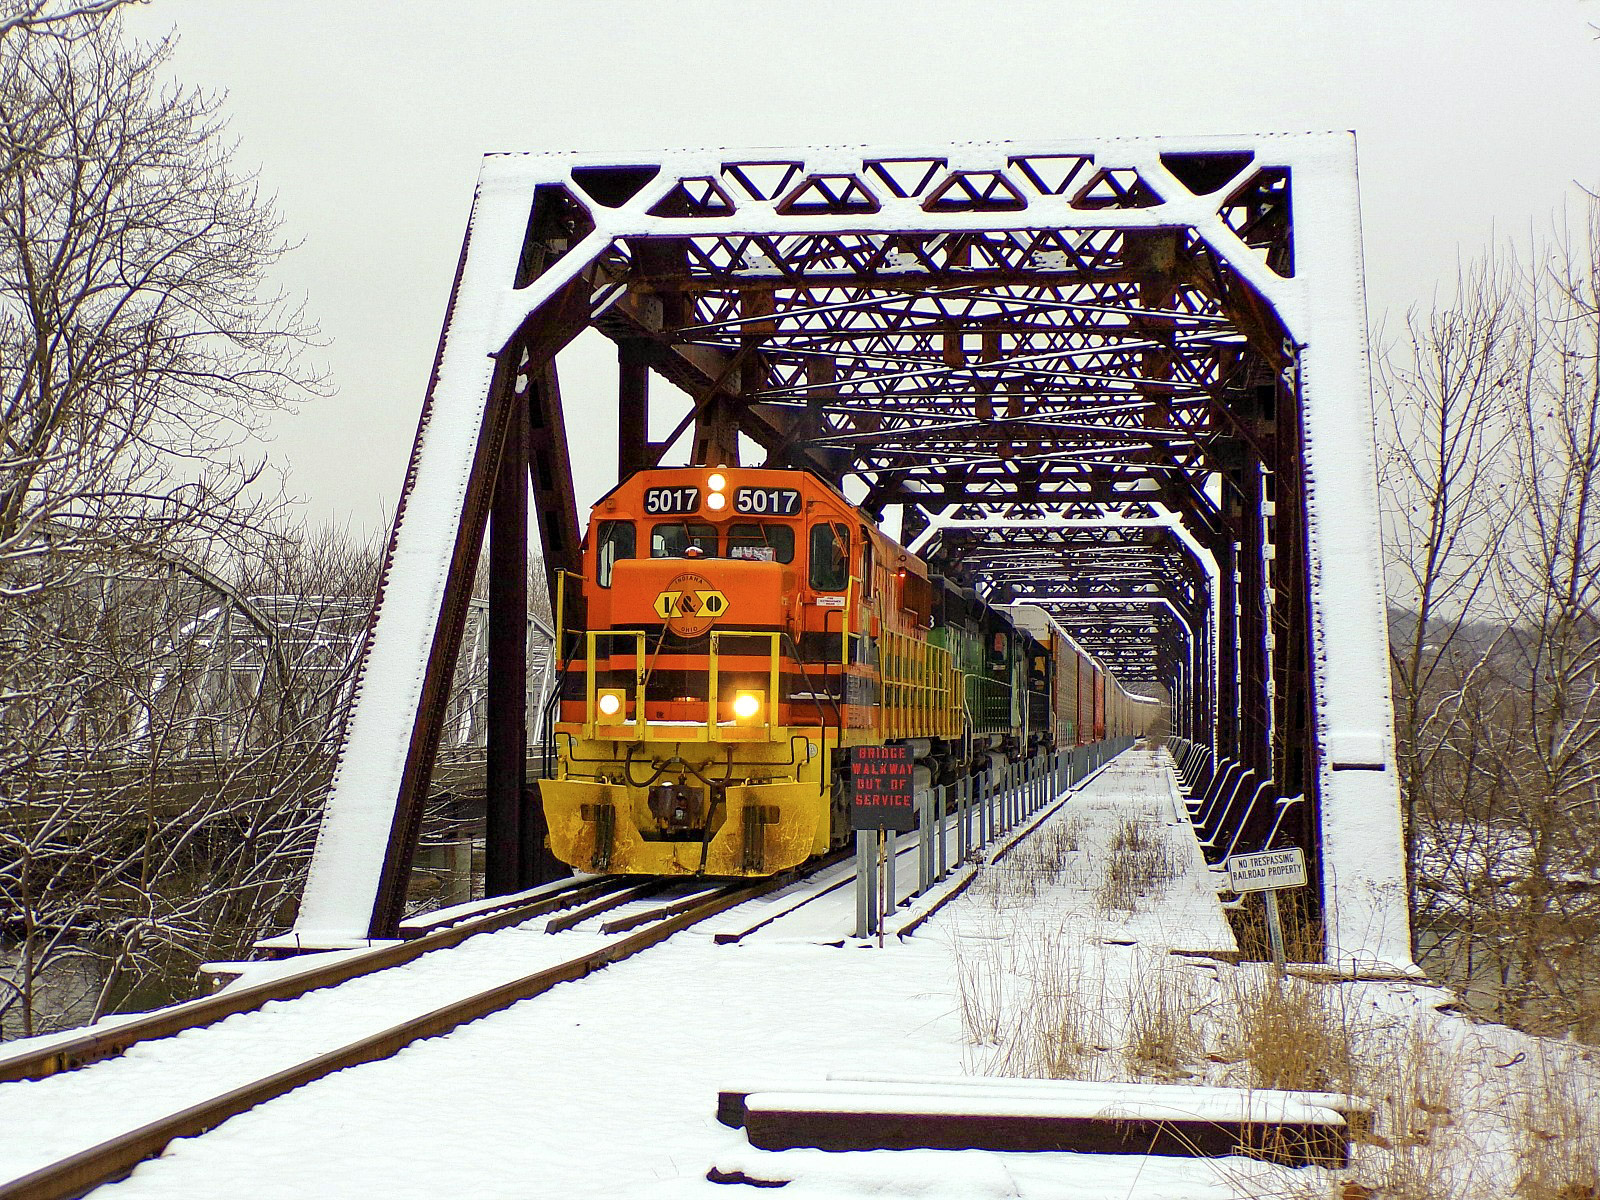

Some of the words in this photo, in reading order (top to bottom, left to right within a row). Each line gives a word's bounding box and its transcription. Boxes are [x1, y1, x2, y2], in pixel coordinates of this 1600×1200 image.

[647, 488, 698, 512] 5017
[737, 489, 798, 513] 5017
[675, 576, 703, 584] INDIANA
[859, 747, 905, 758] BRIDGE
[852, 763, 912, 775] WALKWAY
[857, 778, 881, 790] OUT
[890, 778, 906, 790] OF
[855, 795, 911, 806] SERVICE
[1238, 859, 1248, 868] NO
[1250, 853, 1294, 867] TRESPASSING
[1232, 868, 1265, 880] RAILROAD
[1268, 864, 1302, 876] PROPERTY
